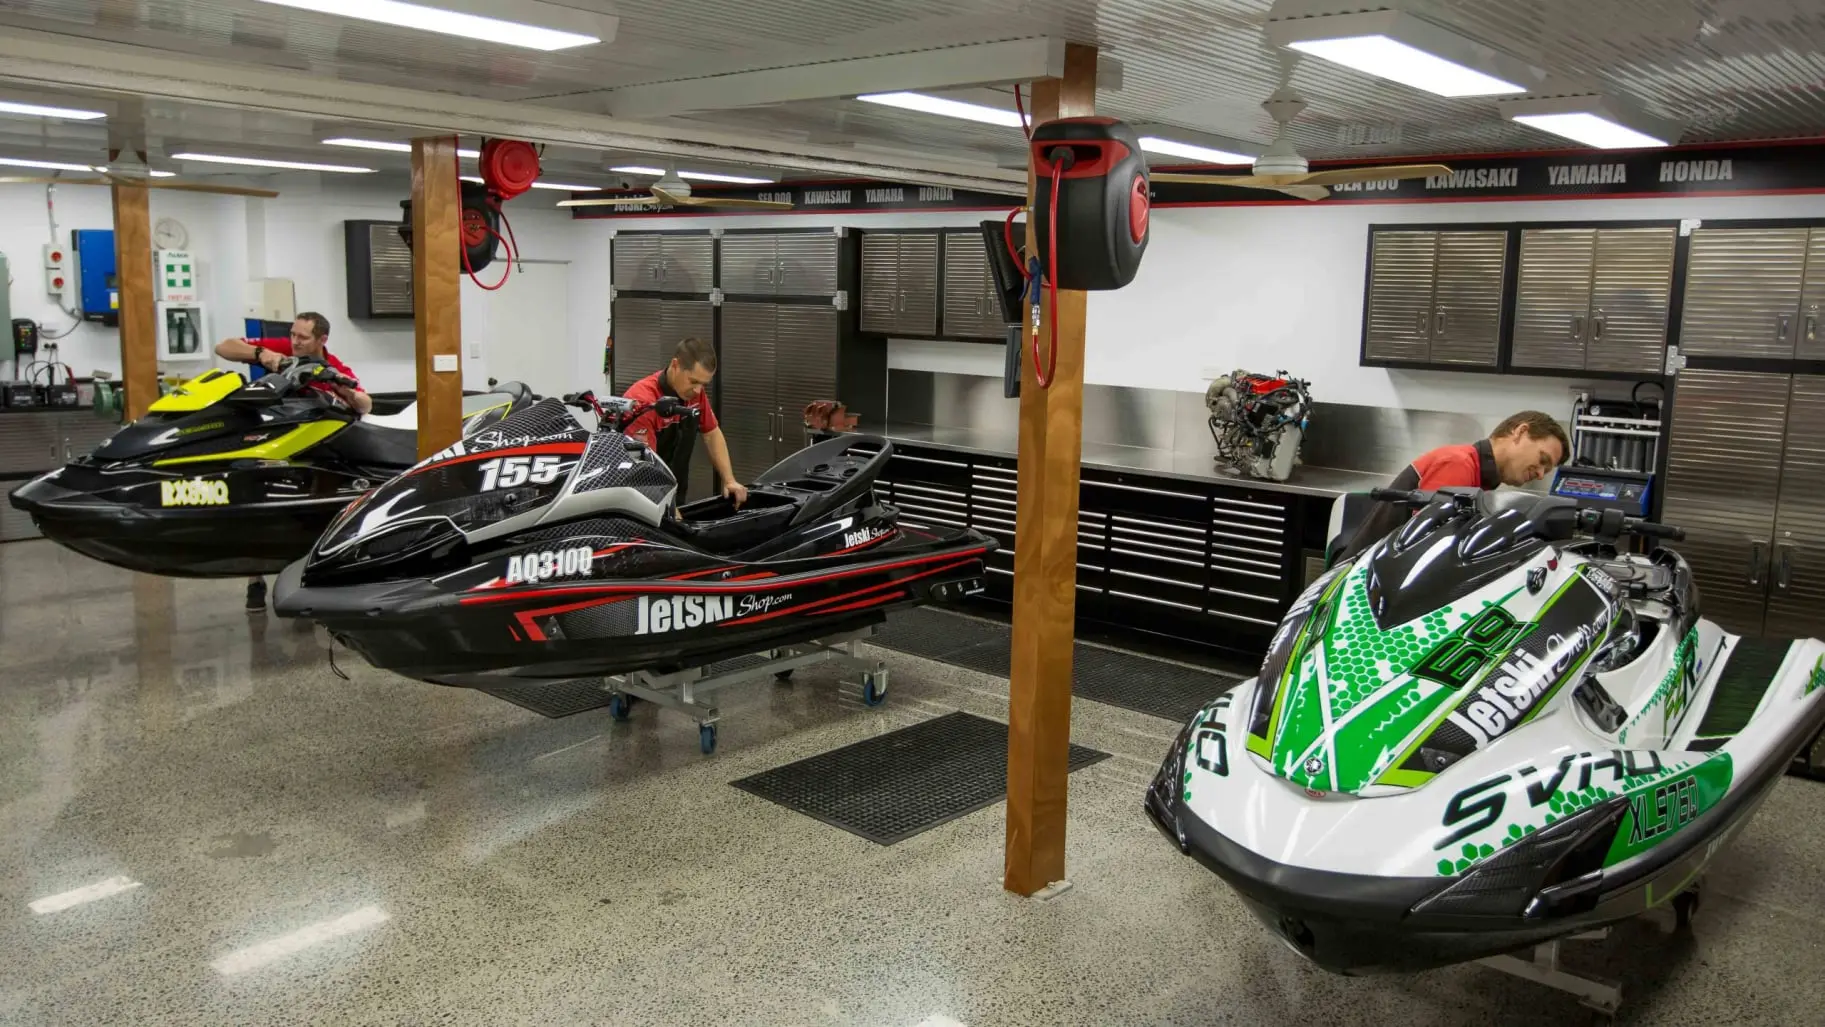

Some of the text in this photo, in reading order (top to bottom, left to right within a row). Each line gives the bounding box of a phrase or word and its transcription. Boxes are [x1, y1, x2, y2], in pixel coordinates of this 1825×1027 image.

[1425, 167, 1518, 190] KAWASAKI
[1547, 163, 1627, 186] YAMAHA
[1659, 159, 1733, 183] HONDA
[804, 189, 851, 205] KAWASAKI
[865, 187, 904, 203] YAMAHA
[919, 186, 954, 202] HONDA
[470, 430, 573, 453] Shop.com
[478, 455, 561, 493] 155
[505, 546, 594, 584] AQ310Q
[735, 591, 793, 618] Shop.com
[1446, 647, 1554, 751] Jetski
[1433, 750, 1662, 851] SVHO
